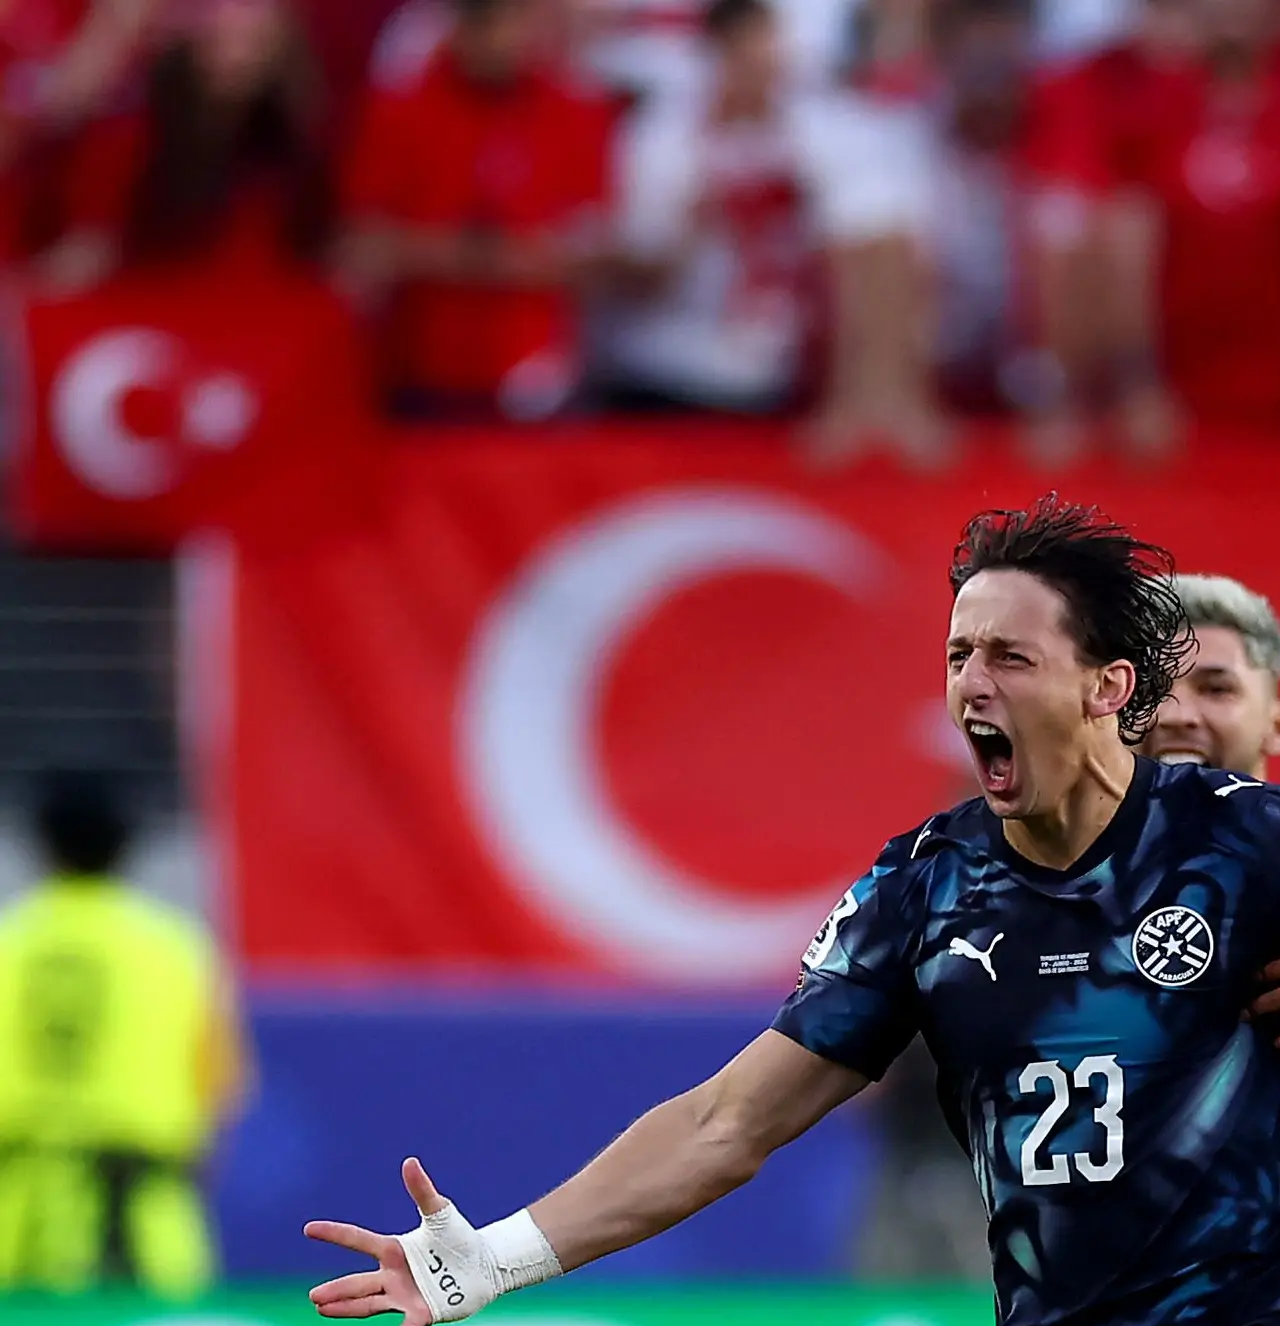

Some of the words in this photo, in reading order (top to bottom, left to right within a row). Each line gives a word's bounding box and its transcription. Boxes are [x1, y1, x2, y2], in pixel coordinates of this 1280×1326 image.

[1156, 910, 1185, 928] APF
[1158, 967, 1195, 981] PARAGUAY
[1018, 1054, 1126, 1186] 23
